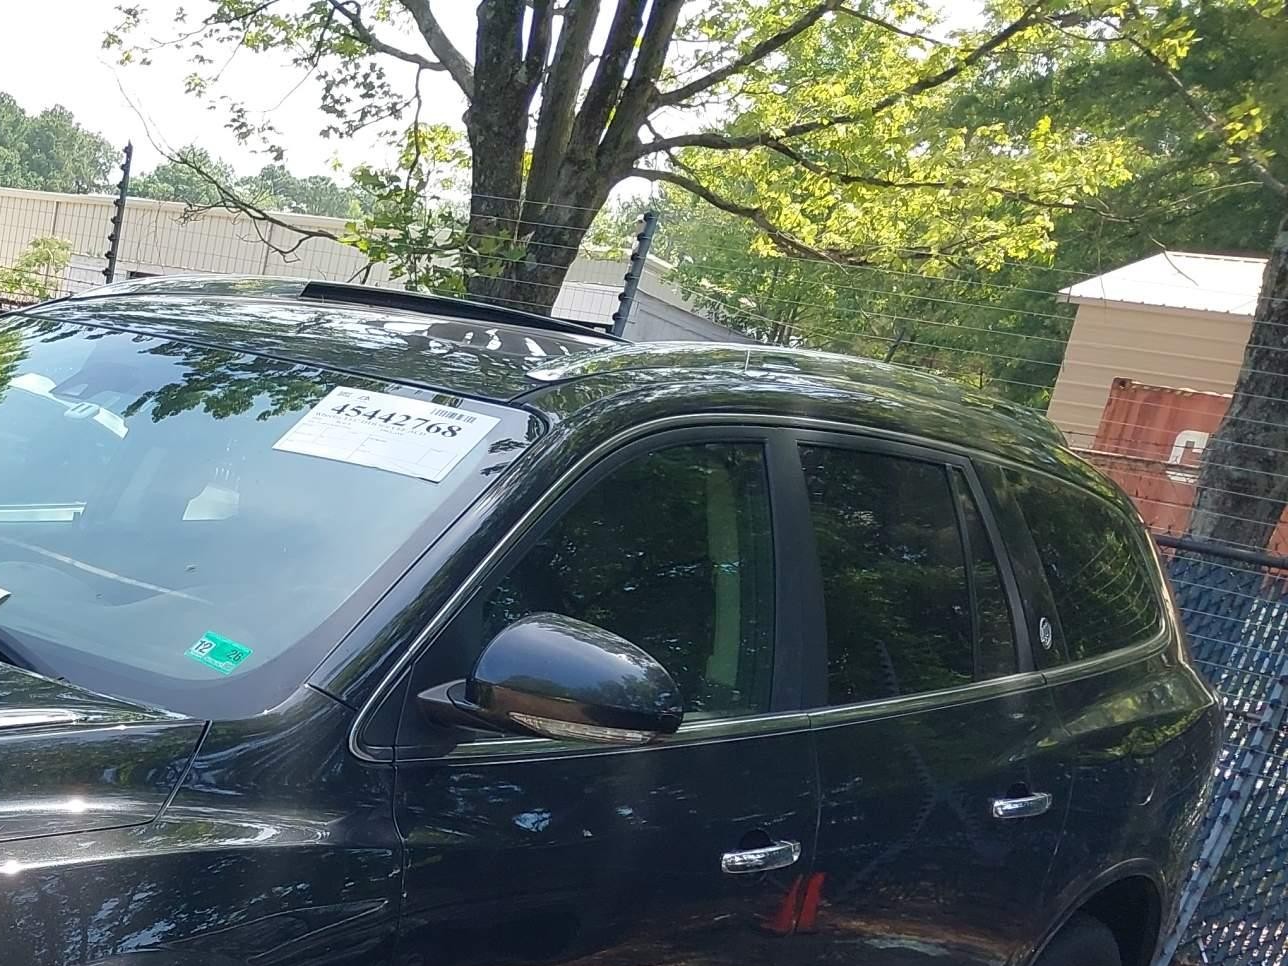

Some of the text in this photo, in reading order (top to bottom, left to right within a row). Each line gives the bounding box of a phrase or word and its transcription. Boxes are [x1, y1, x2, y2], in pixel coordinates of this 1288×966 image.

[330, 403, 463, 438] 45442768
[194, 639, 244, 662] 12 26
